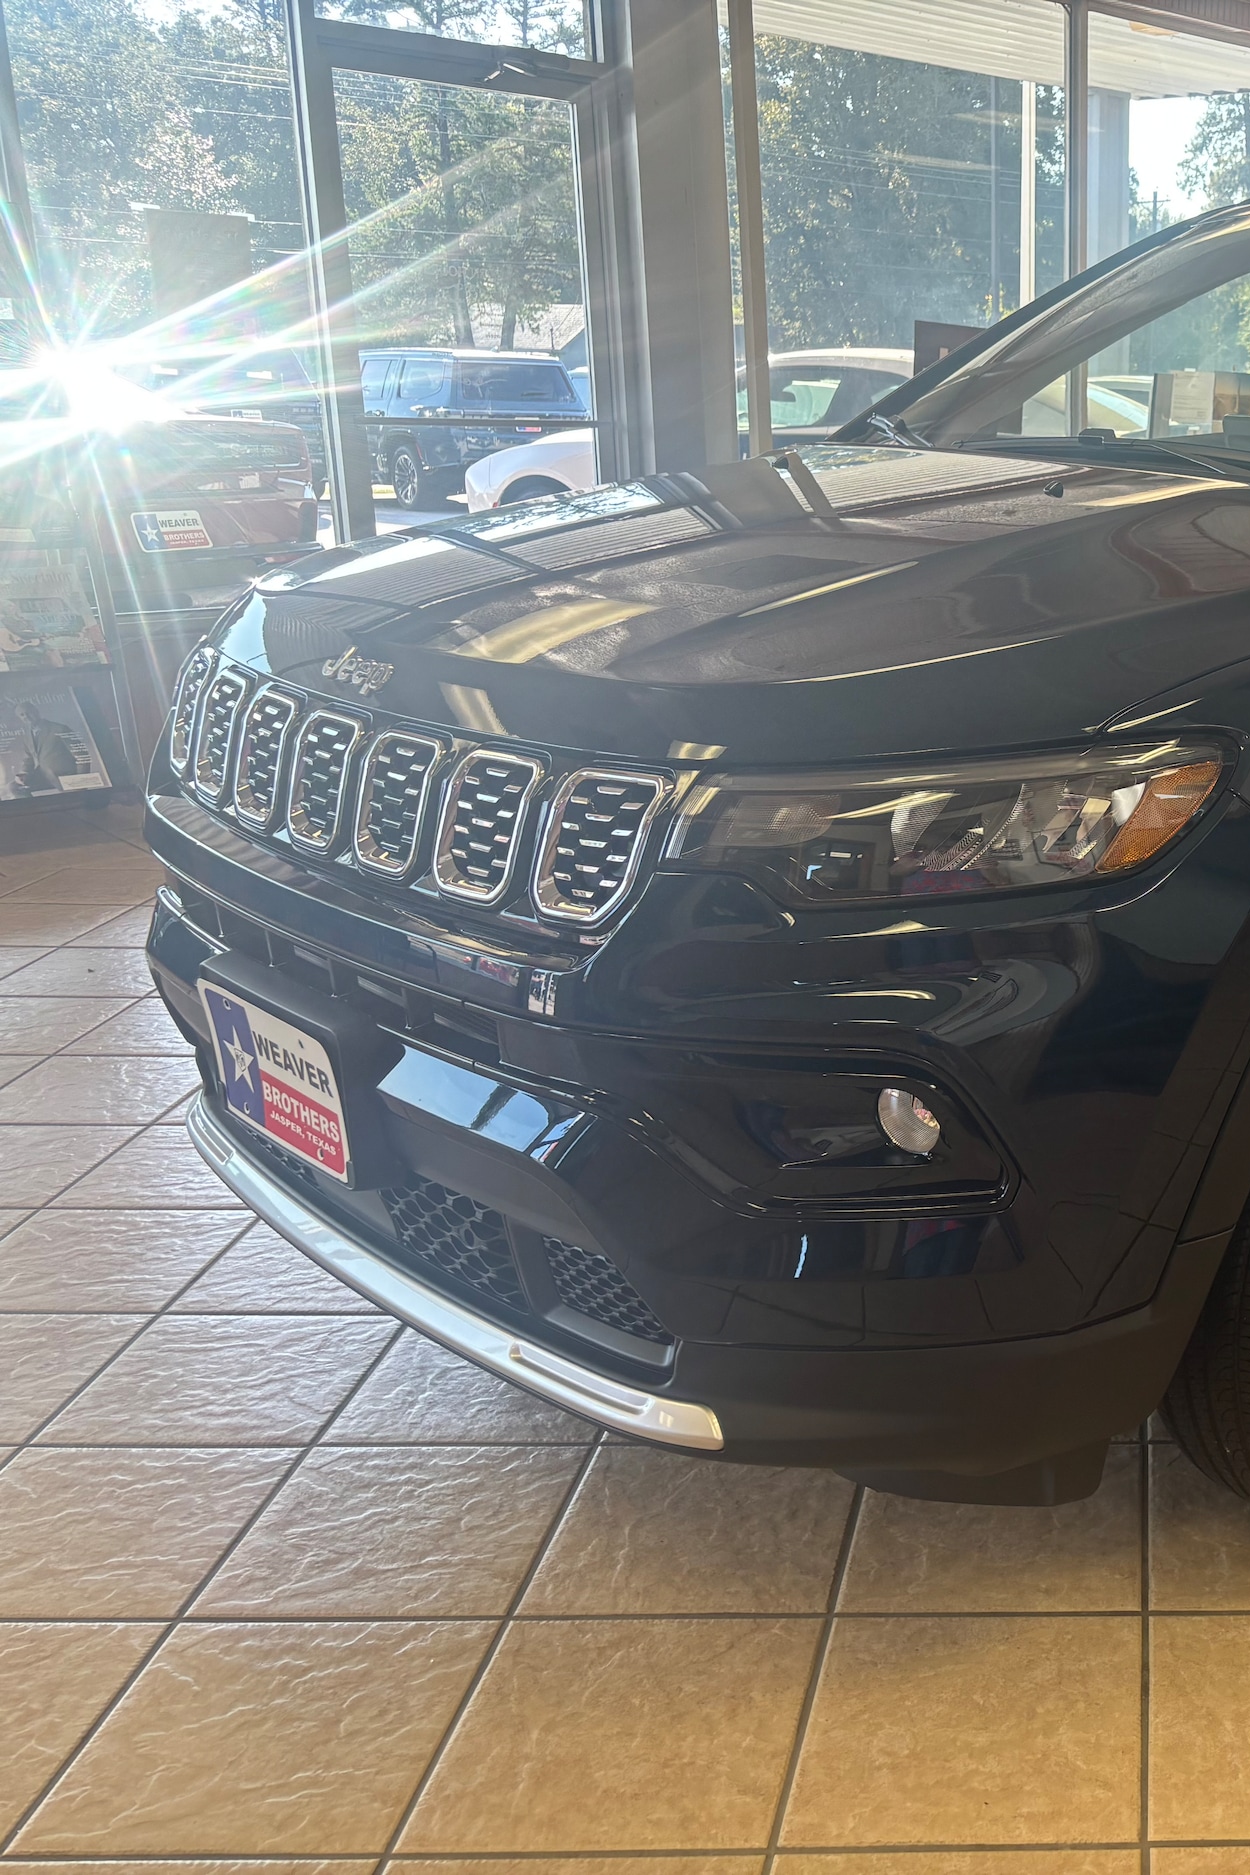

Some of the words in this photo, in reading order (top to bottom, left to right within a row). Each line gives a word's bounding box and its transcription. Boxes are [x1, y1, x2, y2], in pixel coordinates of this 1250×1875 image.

[158, 518, 199, 528] WEAVER
[163, 531, 205, 541] BROTHERS
[321, 645, 395, 697] Jeep
[252, 1031, 333, 1098] WEAVER
[262, 1080, 340, 1143] BROTHERS
[270, 1110, 305, 1139] JASPER,
[306, 1131, 337, 1156] TEXAS
